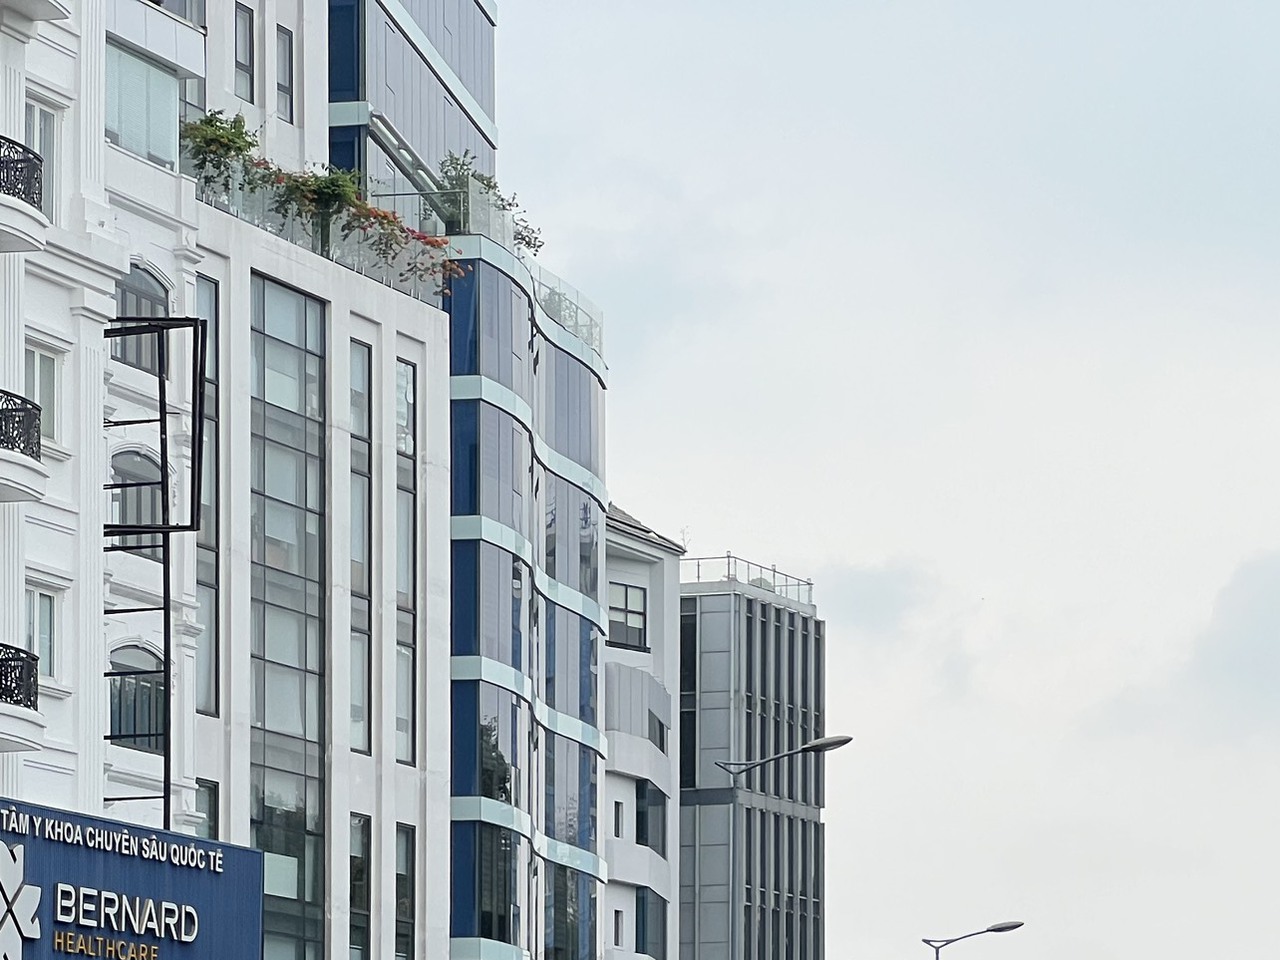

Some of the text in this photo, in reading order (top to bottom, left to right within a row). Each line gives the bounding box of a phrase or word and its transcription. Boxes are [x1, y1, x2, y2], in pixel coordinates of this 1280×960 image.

[1, 806, 29, 835] TÂM
[33, 816, 42, 837] Y
[45, 818, 83, 846] KHOA
[86, 827, 138, 856] CHUYÊN
[142, 834, 167, 862] SÂU
[170, 843, 206, 869] QUỐC
[56, 882, 199, 943] BERNARD
